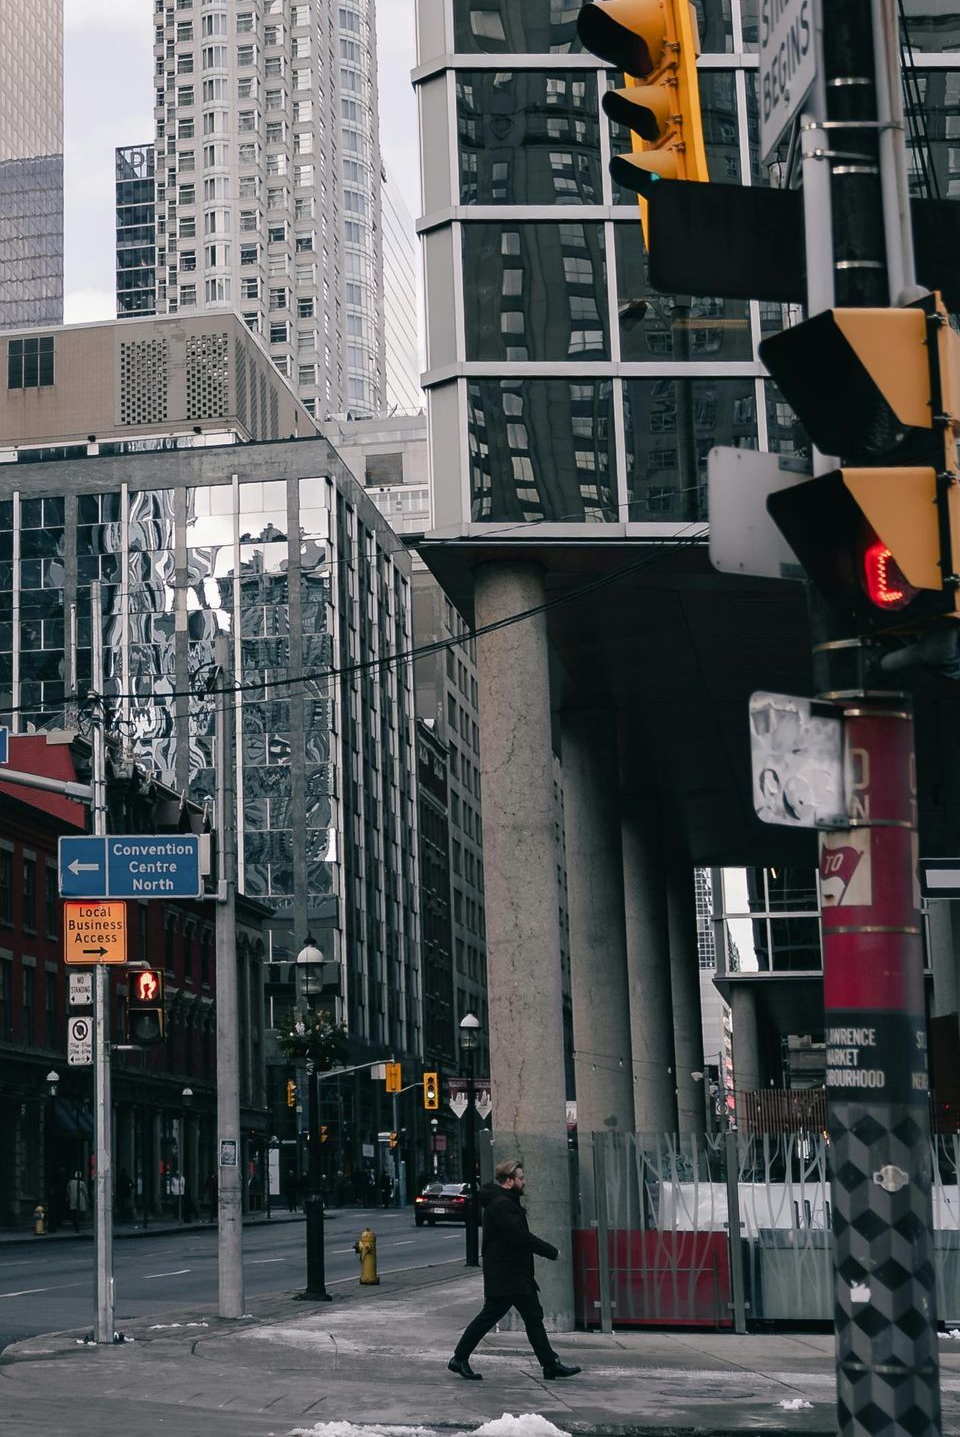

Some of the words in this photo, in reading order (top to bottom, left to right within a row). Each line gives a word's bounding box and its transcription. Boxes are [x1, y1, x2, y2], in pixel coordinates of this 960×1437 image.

[763, 0, 810, 121] BEGINS
[113, 843, 193, 856] Convention
[129, 860, 177, 873] Centre
[825, 852, 844, 875] TO
[132, 878, 174, 891] North
[79, 906, 111, 918] Local
[68, 919, 123, 931] Business
[74, 932, 117, 943] Access
[76, 975, 85, 984] NO
[70, 985, 91, 994] STANDING
